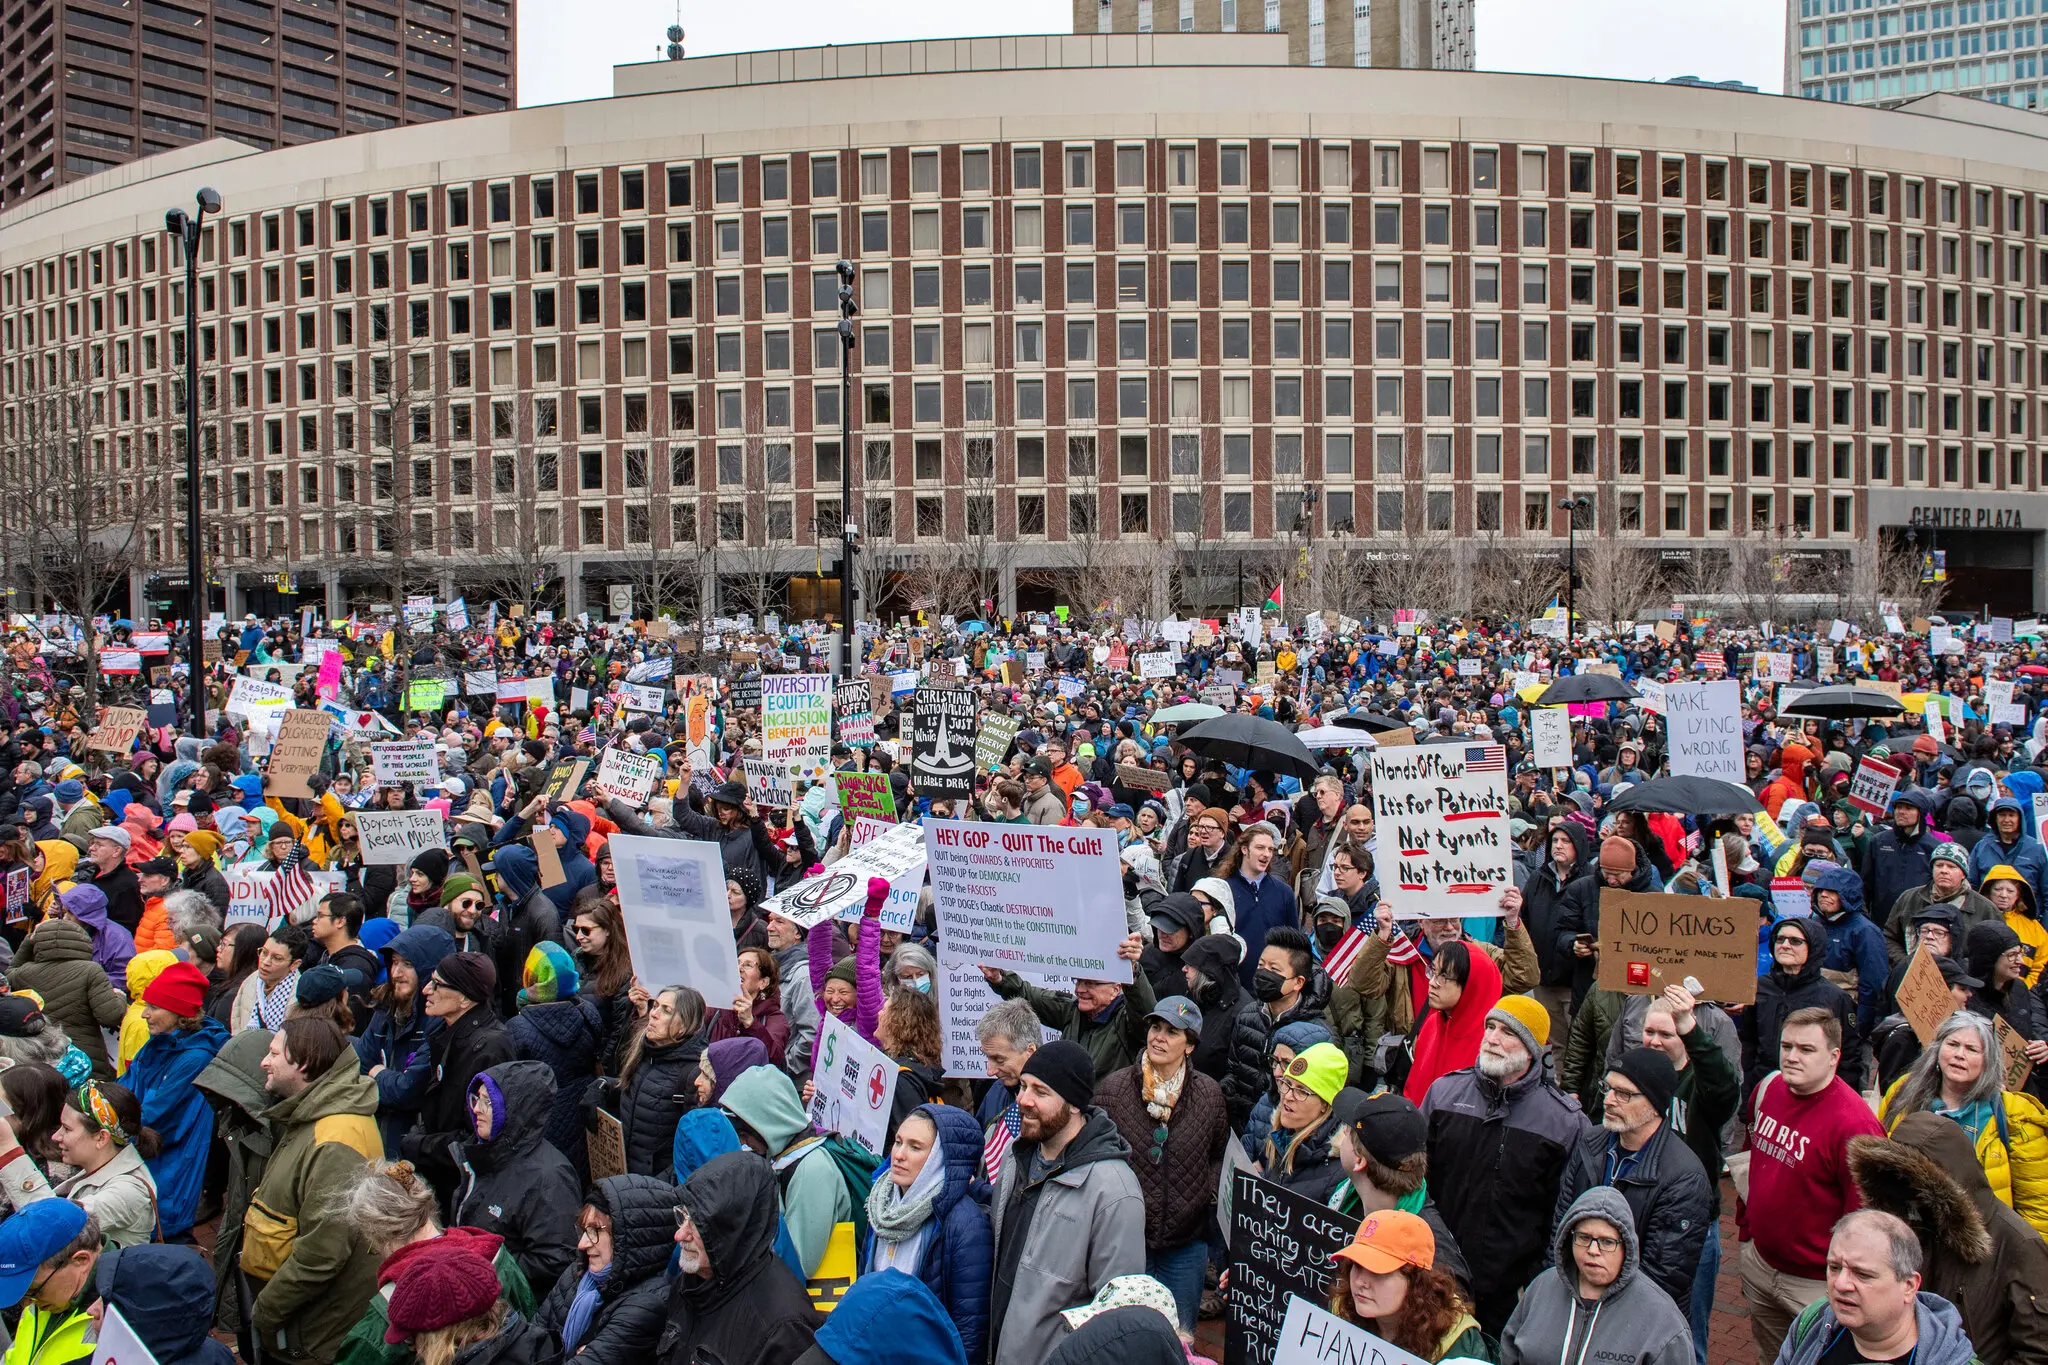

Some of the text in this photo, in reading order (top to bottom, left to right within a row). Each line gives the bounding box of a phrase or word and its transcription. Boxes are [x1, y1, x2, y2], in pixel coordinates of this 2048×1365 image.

[1913, 506, 2022, 528] CENTER PLAZA
[932, 661, 954, 676] DEI
[241, 680, 285, 698] Resister
[763, 676, 829, 694] DIVERSITY
[837, 682, 870, 705] HANDS
[768, 695, 814, 710] EQUITY
[916, 690, 971, 705] CHRISTIAN
[1666, 690, 1710, 712] MAKE
[916, 703, 974, 716] NATIONALISM
[282, 711, 331, 726] DANGEROUS
[763, 710, 828, 727] INCLUSION
[840, 713, 873, 731] TRANS
[928, 717, 973, 730] IS JUST
[989, 714, 1017, 729] GOVT
[1688, 716, 1735, 735] LYING
[104, 727, 134, 747] TRUMP
[353, 730, 380, 738] PROCESS
[768, 726, 829, 740] BENEFIT ALL
[983, 724, 1012, 740] WORKERS
[788, 738, 806, 746] AND
[978, 734, 1006, 751] DESERVE
[1681, 740, 1730, 756] WRONG
[616, 752, 652, 769] PROTECT
[768, 746, 828, 760] HURT NO ONE
[269, 759, 318, 774] EVERYTHING
[606, 759, 654, 780] OUR PLANET!
[746, 762, 786, 779] HANDS OFF
[1374, 756, 1417, 780] Hands
[1442, 761, 1464, 778] our
[1695, 760, 1736, 773] AGAIN
[546, 781, 563, 796] OFF
[618, 775, 637, 787] NOT
[914, 776, 922, 786] IN
[946, 778, 970, 789] DRAG
[604, 783, 649, 805] ABUSERS!
[749, 786, 792, 807] DEMOCRACY
[1379, 794, 1403, 816] It's
[1406, 794, 1433, 814] for
[359, 814, 436, 836] Boycott TESLA
[366, 832, 406, 850] Recall
[936, 828, 1102, 856] HEY GOP QUIT The Cult!
[1398, 825, 1498, 856] Not tyrants
[935, 850, 1054, 869] QUIT being COWARDS & HYPOCRITES
[937, 866, 1021, 883] STAND UP for DEMOCRACY
[1399, 860, 1507, 884] Not traitors
[902, 891, 917, 903] on
[938, 881, 997, 896] STOP the FASCISTS
[940, 896, 956, 907] STOP
[981, 900, 1004, 913] Chaotic
[1006, 904, 1054, 917] DESTRUCTION
[943, 911, 1077, 935] UPHOLD your OATH to the CONSTITUTION
[1620, 908, 1735, 936] NO KINGS
[945, 927, 1026, 945] UPHOLD the RULE of LAW
[948, 942, 1105, 970] ABANDON your CRUELTY; think of the CHILDREN
[1613, 942, 1623, 953] I
[1629, 943, 1671, 955] THOUGHT
[1675, 949, 1689, 957] WE
[1695, 950, 1718, 959] MADE
[1657, 957, 1685, 965] CLEAR
[950, 974, 962, 983] Our
[950, 988, 985, 999] Our Rights
[951, 1002, 984, 1012] Our Social
[952, 1032, 972, 1042] FEMA,
[953, 1046, 967, 1056] FDA,
[847, 1055, 860, 1071] HANDS
[953, 1061, 982, 1071] IRS, FAA,
[845, 1064, 858, 1084] OFF!
[814, 1096, 825, 1114] OFF!
[859, 1134, 873, 1152] HANDS
[1238, 1176, 1291, 1230] They
[1238, 1212, 1299, 1260] making
[1234, 1263, 1275, 1303] They
[1594, 1351, 1636, 1364] ADDUCO
